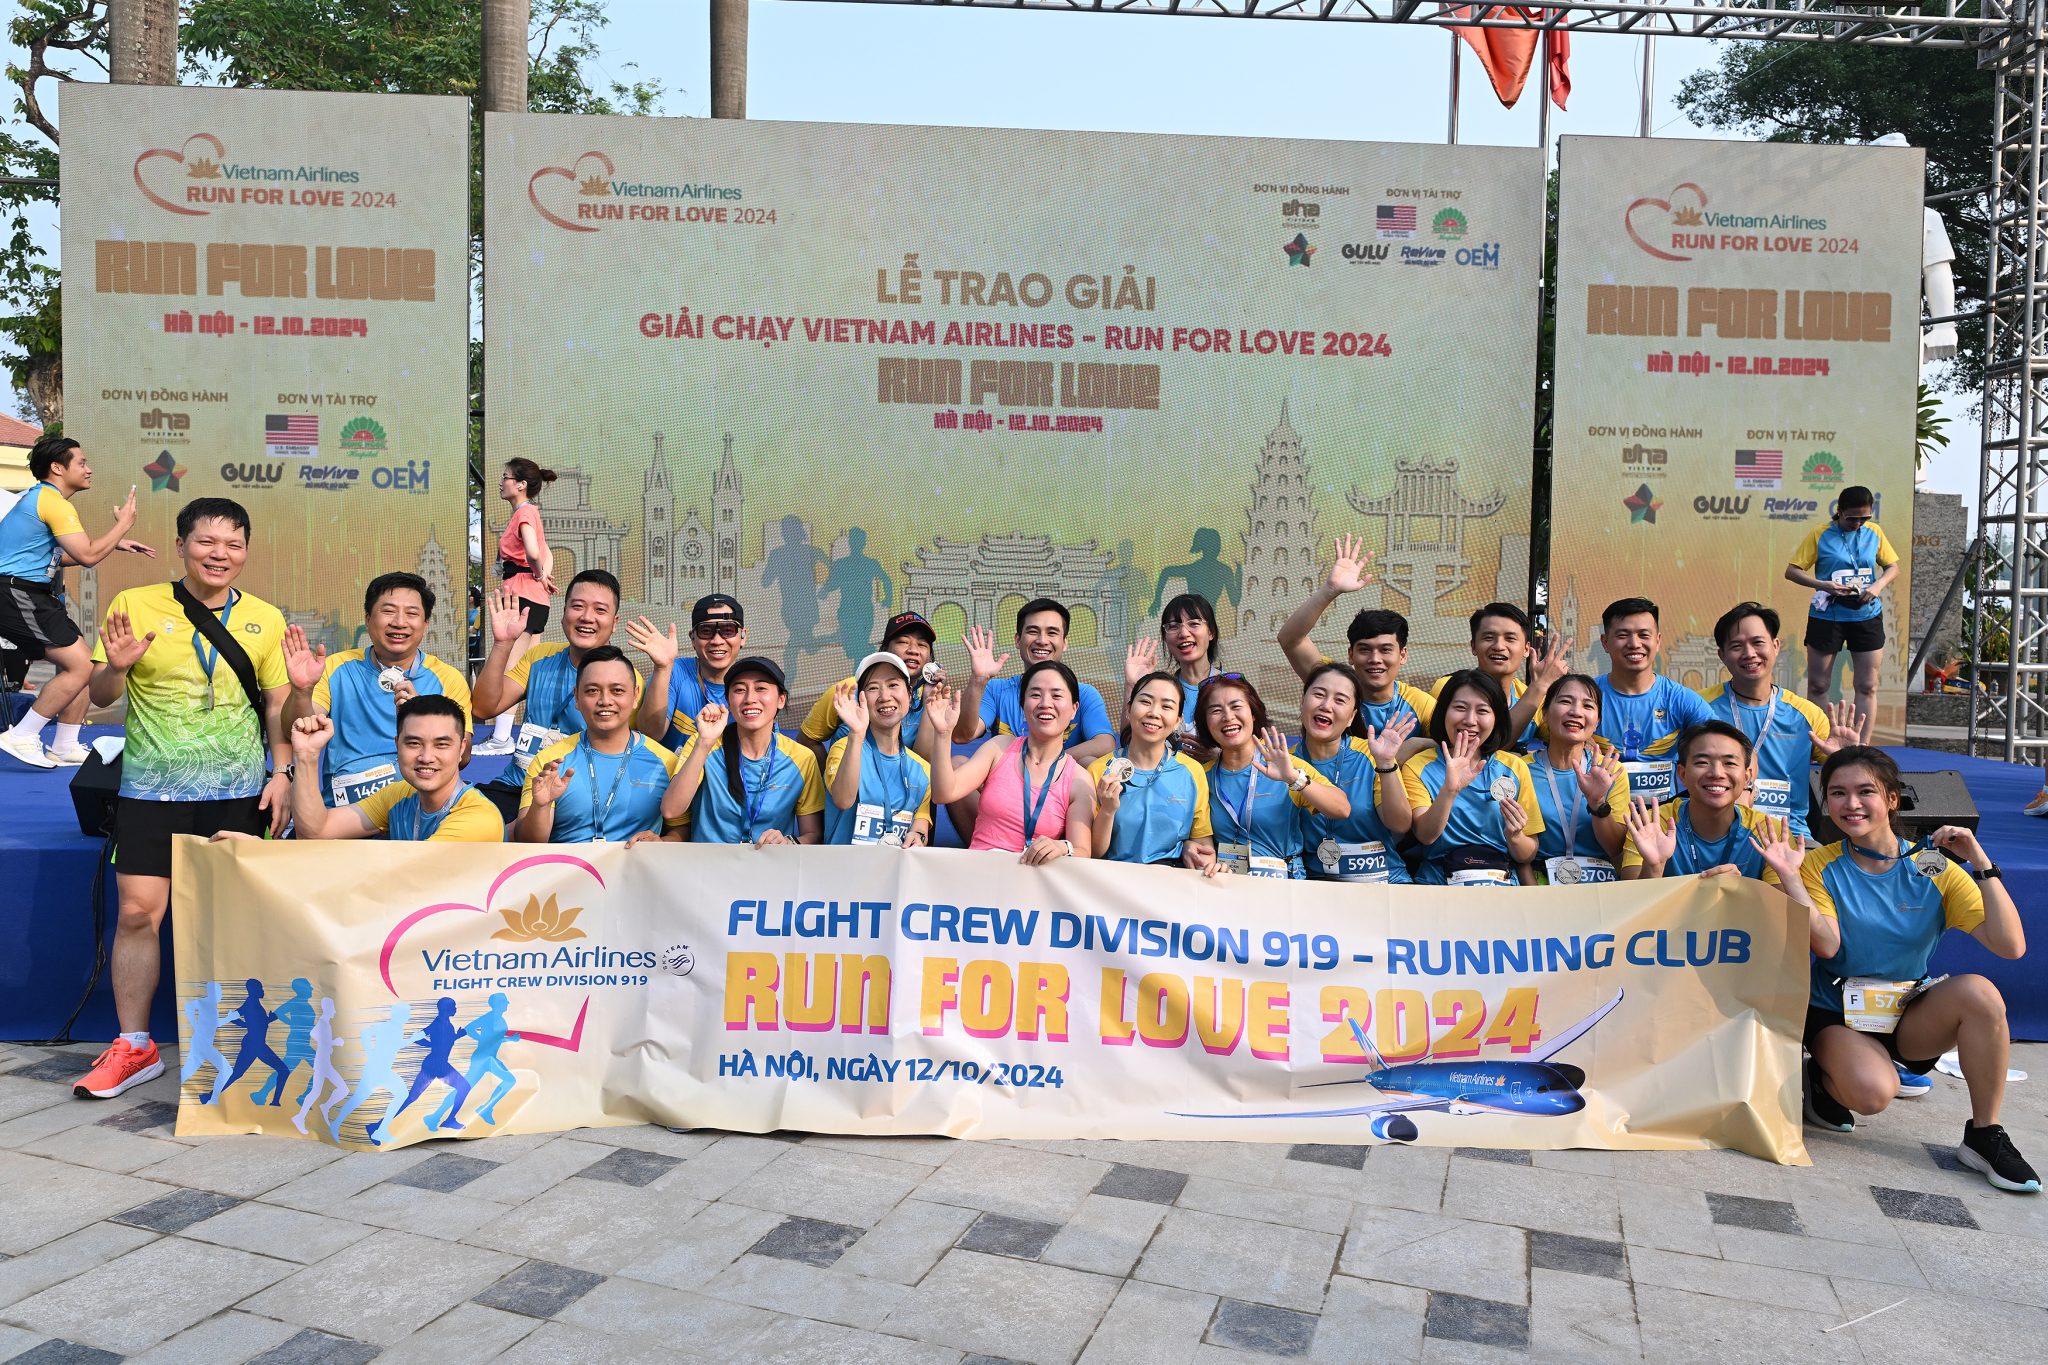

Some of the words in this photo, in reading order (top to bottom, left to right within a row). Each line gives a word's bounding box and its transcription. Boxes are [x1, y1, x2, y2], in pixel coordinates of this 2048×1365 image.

[220, 164, 293, 182] Vietnam
[294, 166, 360, 183] Airlines
[186, 186, 235, 204] RUN
[241, 188, 284, 205] FOR
[289, 189, 345, 206] LOVE
[351, 192, 397, 208] 2024
[611, 181, 681, 198] Vietnam
[682, 184, 742, 200] Airlines
[578, 203, 624, 219] RUN
[629, 205, 670, 221] FOR
[675, 206, 728, 223] LOVE
[734, 207, 778, 224] 2024
[1704, 211, 1768, 229] Vietnam
[1769, 213, 1827, 230] Airlines
[1341, 243, 1388, 260] GULU
[1671, 233, 1715, 250] RUN
[1720, 235, 1758, 252] FOR
[1764, 236, 1813, 253] LOVE
[1818, 237, 1859, 254] 2024
[1455, 242, 1500, 266] OEM
[95, 240, 197, 295] RUN
[206, 243, 307, 298] FOR
[876, 253, 922, 304] LỄ
[933, 270, 1053, 308] TRAO
[1065, 264, 1156, 311] GIẢI
[1586, 284, 1679, 337] RUN
[1687, 287, 1778, 339] FOR
[164, 309, 192, 334] HÀ
[253, 316, 367, 338] 12.10.2024
[639, 306, 704, 339] GIẢI
[712, 315, 795, 348] CHẠY
[802, 317, 935, 345] VIETNAM
[943, 321, 1074, 348] AIRLINES
[1105, 325, 1164, 351] RUN
[1172, 327, 1232, 353] FOR
[1239, 329, 1315, 355] LOVE
[1322, 331, 1392, 357] 2024
[1647, 350, 1673, 373] HÀ
[1727, 355, 1830, 376] 12.10.2024
[877, 357, 962, 404] RUN
[970, 359, 1054, 407] FOR
[102, 389, 132, 400] ĐƠN
[136, 390, 147, 402] VỊ
[151, 388, 188, 401] ĐỒNG
[192, 389, 228, 402] HÀNH
[277, 393, 308, 404] ĐƠN
[311, 394, 323, 406] VỊ
[327, 392, 346, 405] TÀI
[350, 395, 378, 408] TRỢ
[1588, 426, 1616, 436] ĐƠN
[1619, 426, 1629, 438] VỊ
[1632, 424, 1667, 438] ĐỒNG
[1670, 426, 1702, 438] HÀNH
[1747, 429, 1774, 440] ĐƠN
[1778, 430, 1788, 442] VỊ
[1792, 428, 1808, 441] TÀI
[1812, 431, 1836, 443] TRỢ
[221, 463, 283, 483] GULU
[372, 460, 430, 489] OEM
[1693, 496, 1749, 514] GULU
[519, 737, 529, 746] M
[1635, 773, 1670, 786] 13095
[336, 792, 346, 801] M
[1759, 792, 1788, 804] 909
[860, 820, 867, 830] F
[1348, 855, 1386, 870] 59912
[727, 899, 891, 940] FLIGHT
[900, 903, 1040, 946] CREW
[1050, 911, 1248, 964] DIVISION
[1263, 930, 1340, 971] 919
[1387, 933, 1616, 977] RUNNING
[1626, 928, 1752, 968] CLUB
[421, 948, 550, 972] Vietnam
[551, 944, 657, 970] Airlines
[433, 977, 492, 991] FLIGHT
[496, 976, 543, 990] CREW
[546, 975, 618, 988] DIVISION
[621, 974, 648, 987] 919
[724, 950, 893, 1035] RUN
[919, 956, 1071, 1043] FOR
[1099, 966, 1291, 1057] LOVE
[1320, 986, 1542, 1064] 2024
[1850, 994, 1858, 1004] F
[719, 1049, 759, 1078] HÀ
[764, 1050, 820, 1084] NỘI,
[826, 1049, 901, 1083] NGÀY
[905, 1057, 1064, 1089] 12/10/2024
[1449, 1072, 1473, 1083] Vietnam
[1473, 1073, 1495, 1086] Airlines
